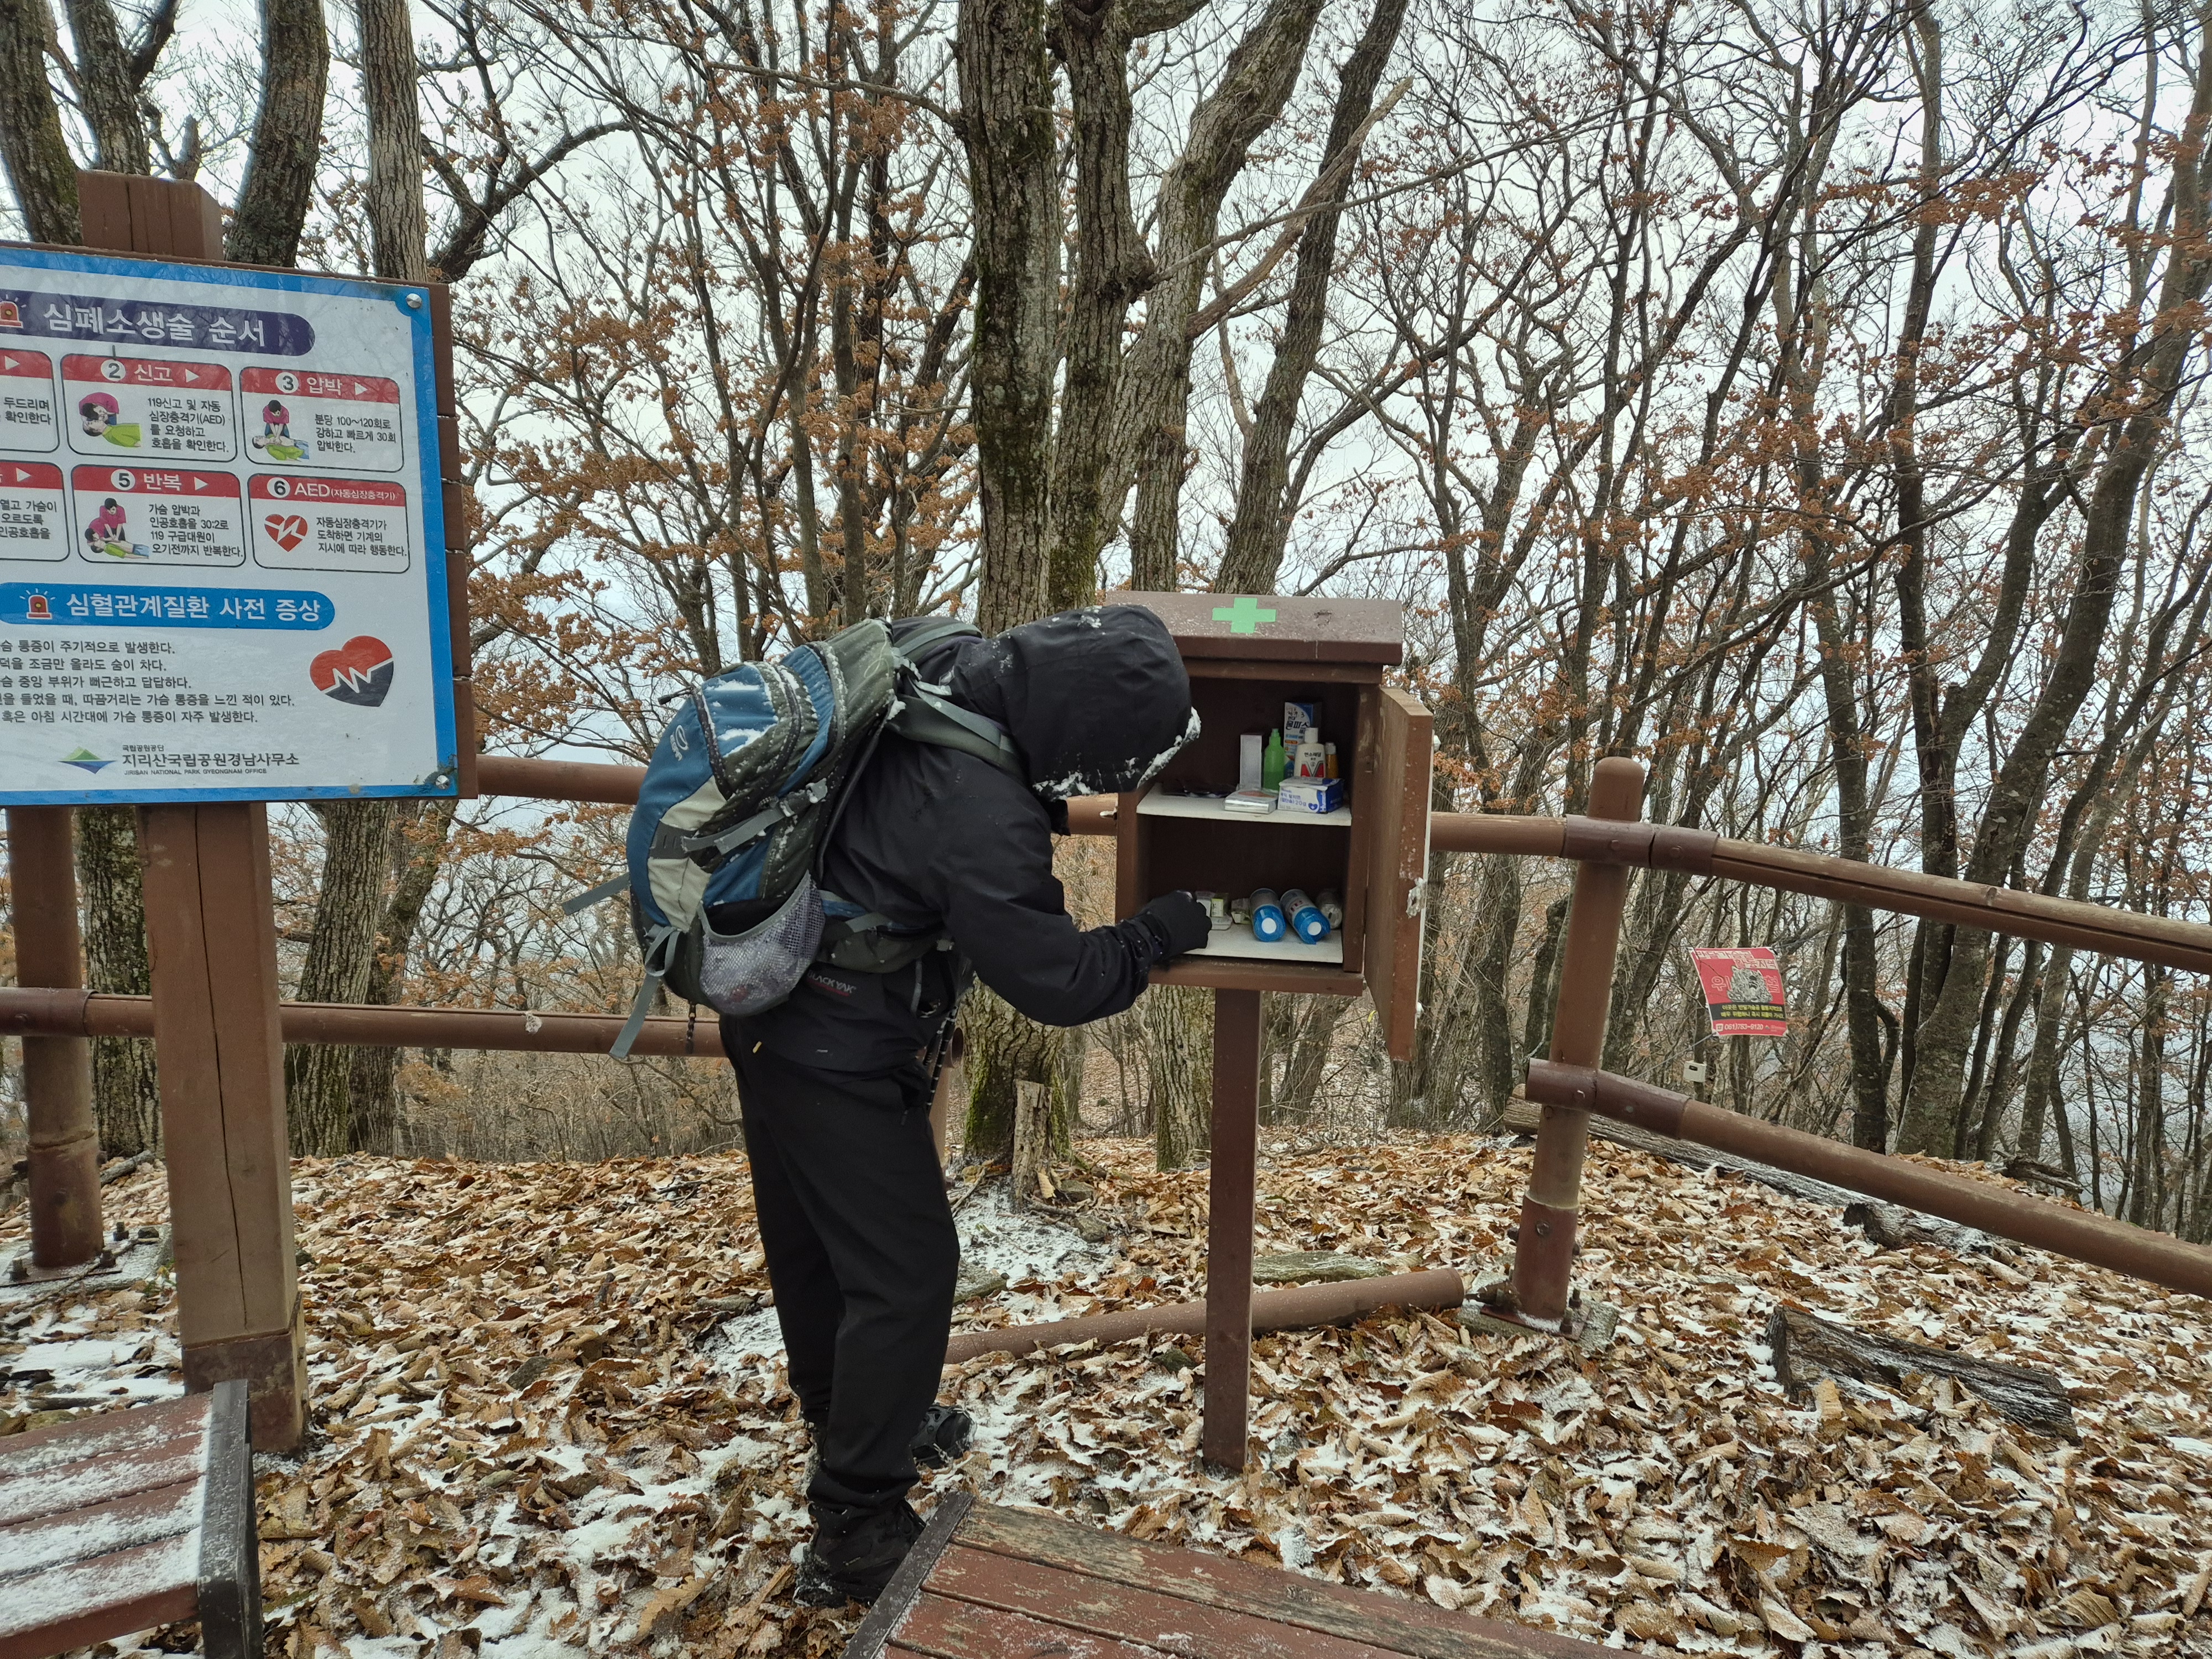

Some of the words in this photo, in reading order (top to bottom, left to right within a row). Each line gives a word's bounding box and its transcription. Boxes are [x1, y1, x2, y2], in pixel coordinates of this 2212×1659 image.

[43, 304, 195, 341] 심폐소생술
[208, 316, 265, 347] 순서
[108, 363, 121, 378] 2
[134, 364, 173, 382] 신고
[282, 375, 294, 390] 3
[306, 377, 342, 395] 압박
[3, 397, 50, 410] 두드리며
[148, 398, 182, 409] 119신고
[186, 399, 196, 410] 및
[201, 400, 221, 412] 자동
[5, 410, 51, 425] 확인한다
[149, 410, 225, 426] 심장충격기(AED)
[315, 414, 333, 426] 분당
[337, 416, 392, 430] 100~120회로
[150, 424, 161, 435] 를
[165, 425, 206, 437] 요청하고
[316, 427, 343, 439] 강하고
[346, 429, 374, 441] 빠르게
[377, 431, 396, 444] 30회
[152, 437, 182, 450] 호흡을
[186, 439, 229, 452] 확인한다.
[118, 472, 131, 488] 5
[143, 473, 182, 491] 반복
[274, 480, 286, 495] 6
[0, 499, 22, 510] 열고
[26, 500, 57, 513] 가슴이
[149, 503, 168, 516] 가슴
[171, 504, 200, 517] 압박과
[1, 513, 44, 525] 오르도록
[149, 517, 197, 530] 인공호흡을
[201, 519, 229, 530] 30:2로
[316, 517, 387, 531] 자동심장충격기가
[150, 530, 164, 540] 119
[167, 530, 215, 543] 구급대원이
[317, 529, 353, 542] 도착하면
[357, 531, 383, 544] 기계의
[152, 543, 200, 556] 오기전까지
[203, 545, 243, 557] 반복한다.
[318, 542, 345, 554] 지시에
[348, 543, 366, 555] 따라
[369, 545, 407, 557] 행동한다.
[66, 593, 211, 619] 심혈관계질환
[219, 597, 265, 620] 사전
[275, 598, 321, 622] 증상
[18, 640, 55, 653] 통증이
[60, 640, 120, 653] 주기적으로
[124, 641, 175, 654] 발생한다.
[29, 658, 65, 670] 조금만
[70, 658, 106, 671] 올라도
[111, 659, 134, 671] 숨이
[140, 659, 166, 671] 차다.
[18, 676, 43, 688] 중앙
[48, 675, 85, 688] 부위가
[90, 676, 137, 688] 뻐근하고
[142, 676, 191, 689] 답답하다.
[20, 693, 57, 706] 들었을
[62, 693, 77, 706] 때,
[83, 693, 142, 706] 따끔거리는
[147, 693, 170, 706] 가슴
[174, 693, 210, 706] 통증을
[214, 694, 237, 706] 느낀
[242, 693, 264, 706] 적이
[269, 694, 295, 706] 있다.
[1, 710, 26, 723] 혹은
[32, 710, 55, 723] 아침
[61, 711, 108, 723] 시간대에
[113, 711, 137, 723] 가슴
[141, 711, 176, 723] 통증이
[181, 711, 205, 723] 자주
[209, 711, 258, 723] 발생한다.
[122, 753, 300, 768] 지리산국립공원경남사무소
